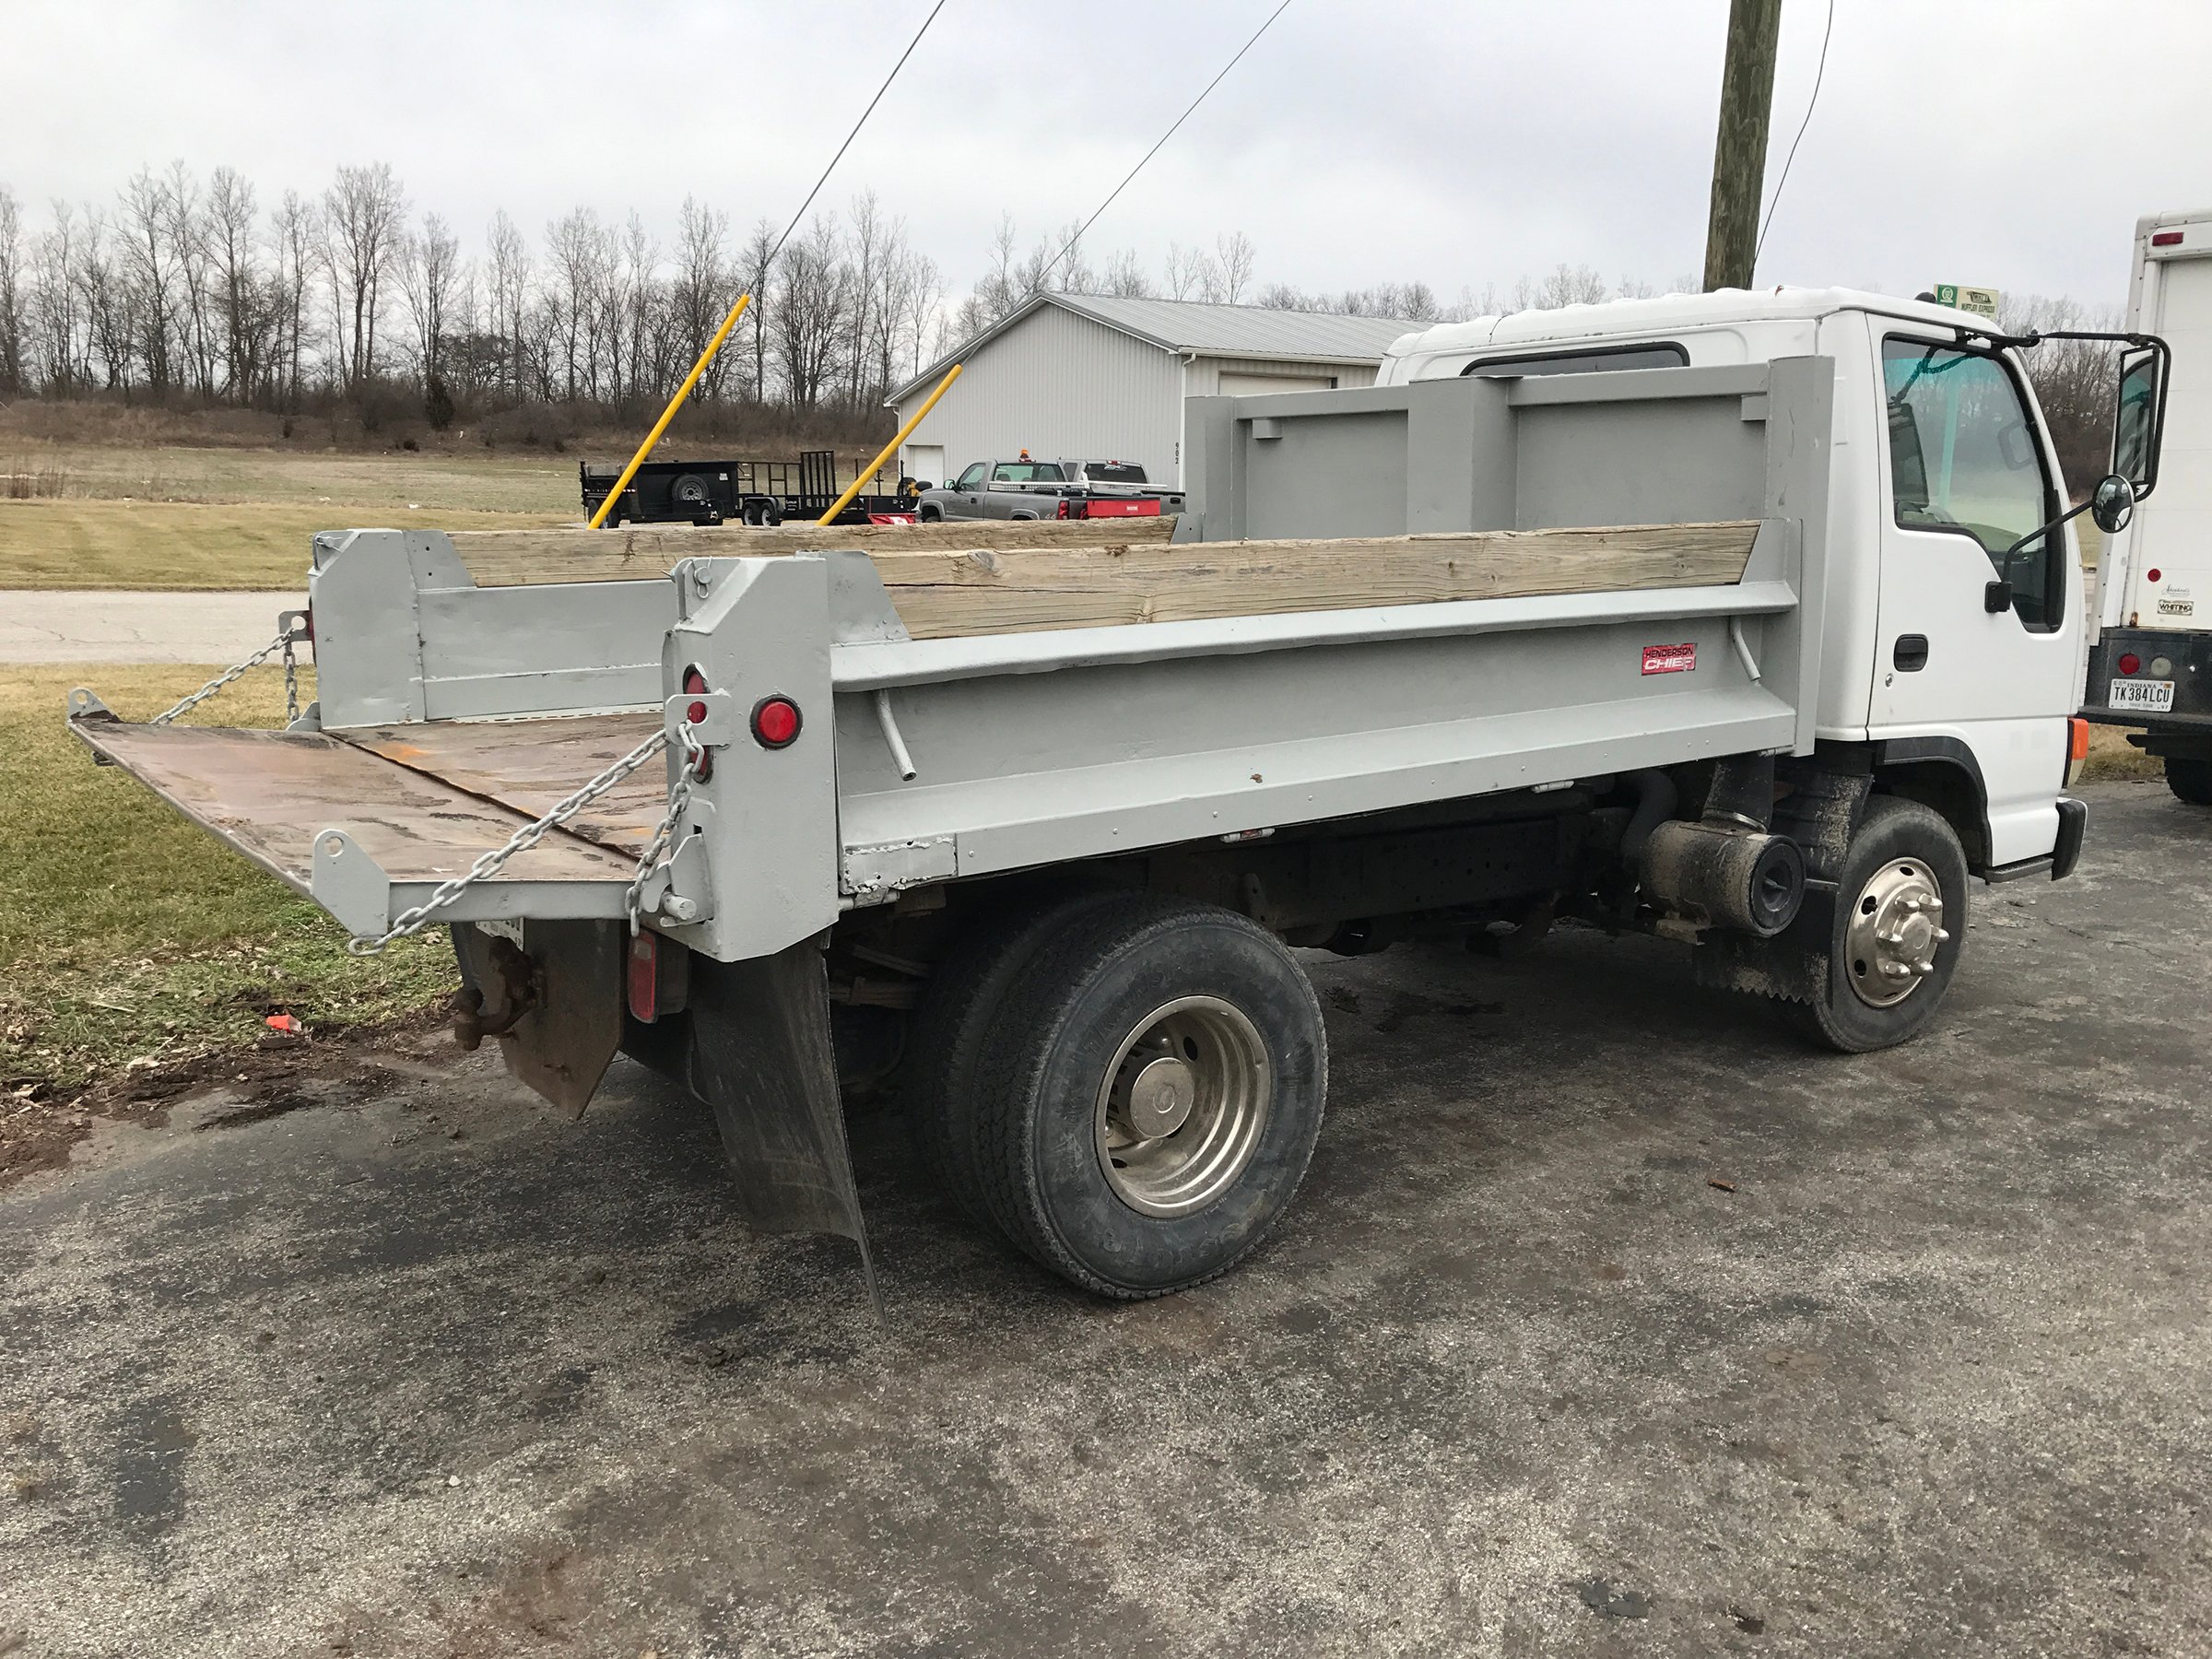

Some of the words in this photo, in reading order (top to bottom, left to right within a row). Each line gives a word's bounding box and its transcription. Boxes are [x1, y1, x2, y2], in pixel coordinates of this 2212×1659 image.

[1978, 304, 1995, 313] EXPRESS
[2159, 603, 2193, 613] WHITING
[1645, 647, 1694, 658] HENDERSON
